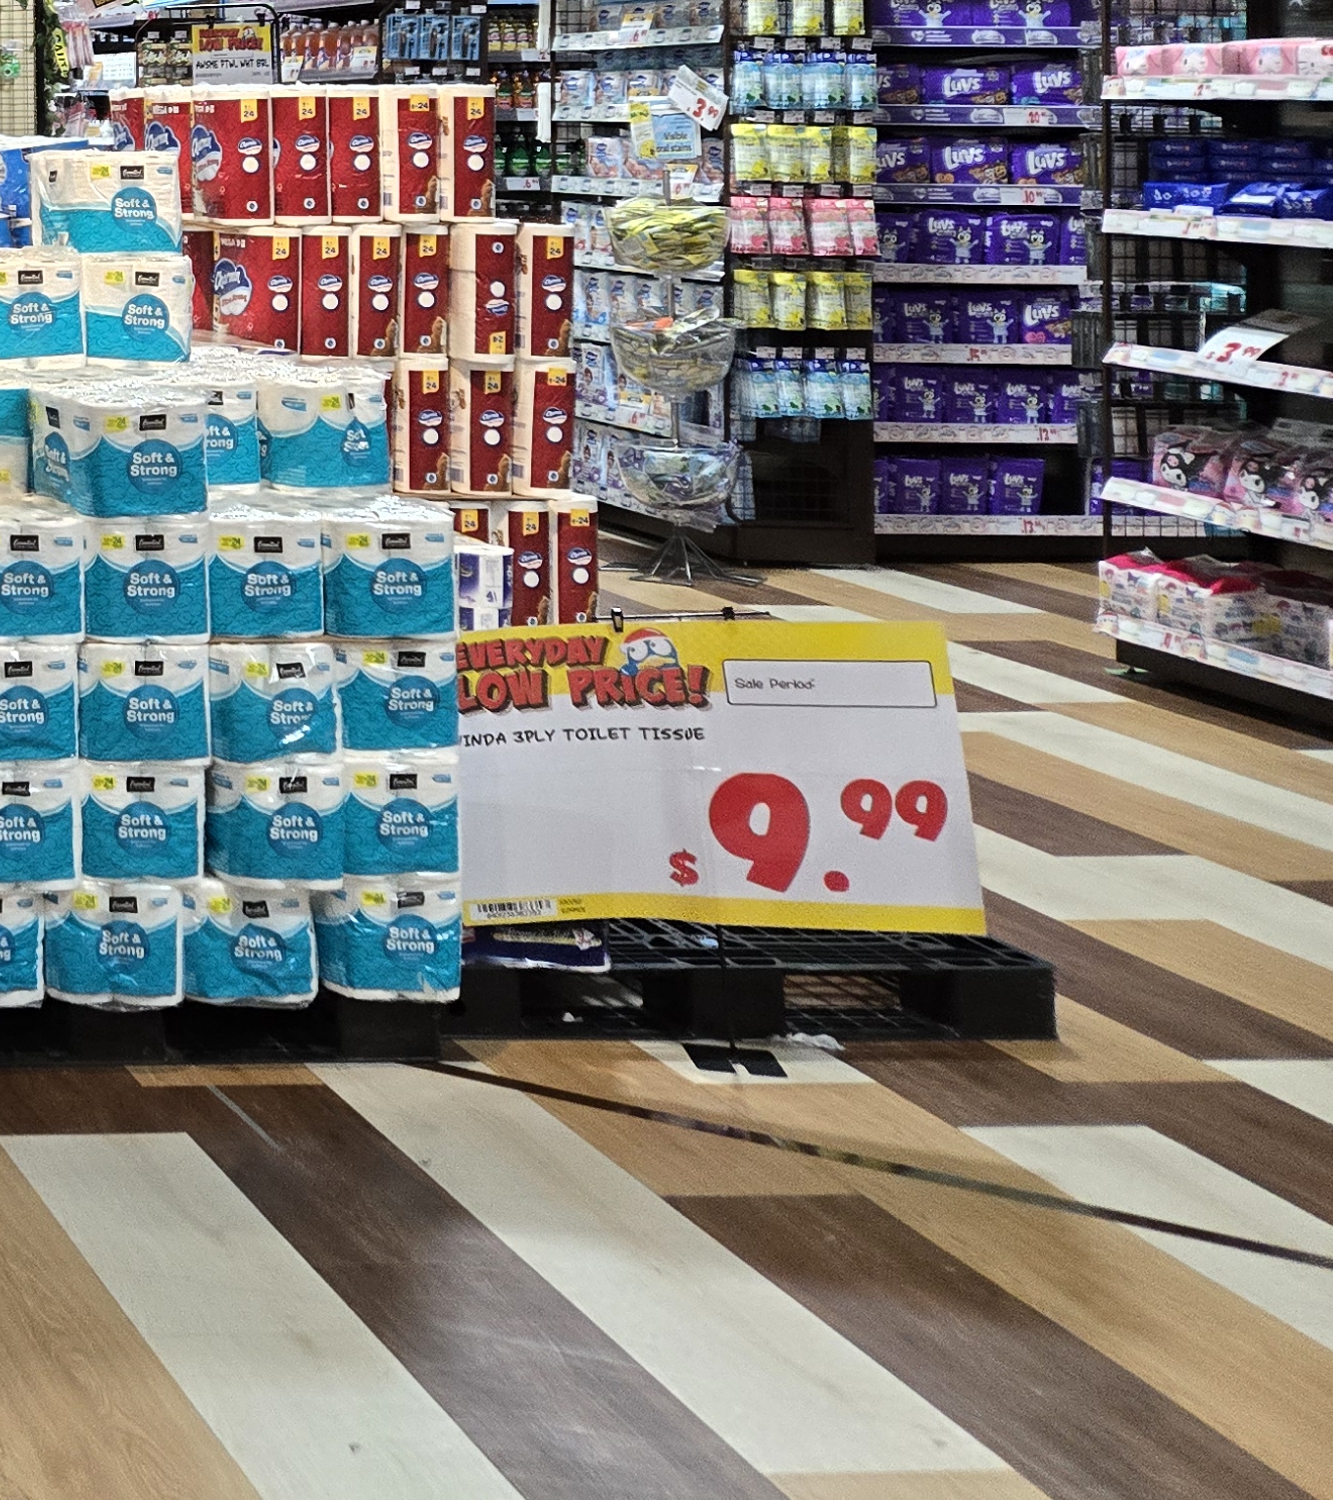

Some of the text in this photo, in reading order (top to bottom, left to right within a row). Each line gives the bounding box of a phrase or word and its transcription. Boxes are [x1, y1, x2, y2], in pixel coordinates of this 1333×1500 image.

[1027, 150, 1066, 174] Luvs
[456, 635, 607, 671] EVERYDAY
[457, 663, 712, 713] LOW PRICE!
[735, 677, 764, 691] Sale
[513, 728, 556, 745] 3PLY
[562, 727, 632, 742] TOILET
[638, 727, 706, 742] TISSUE
